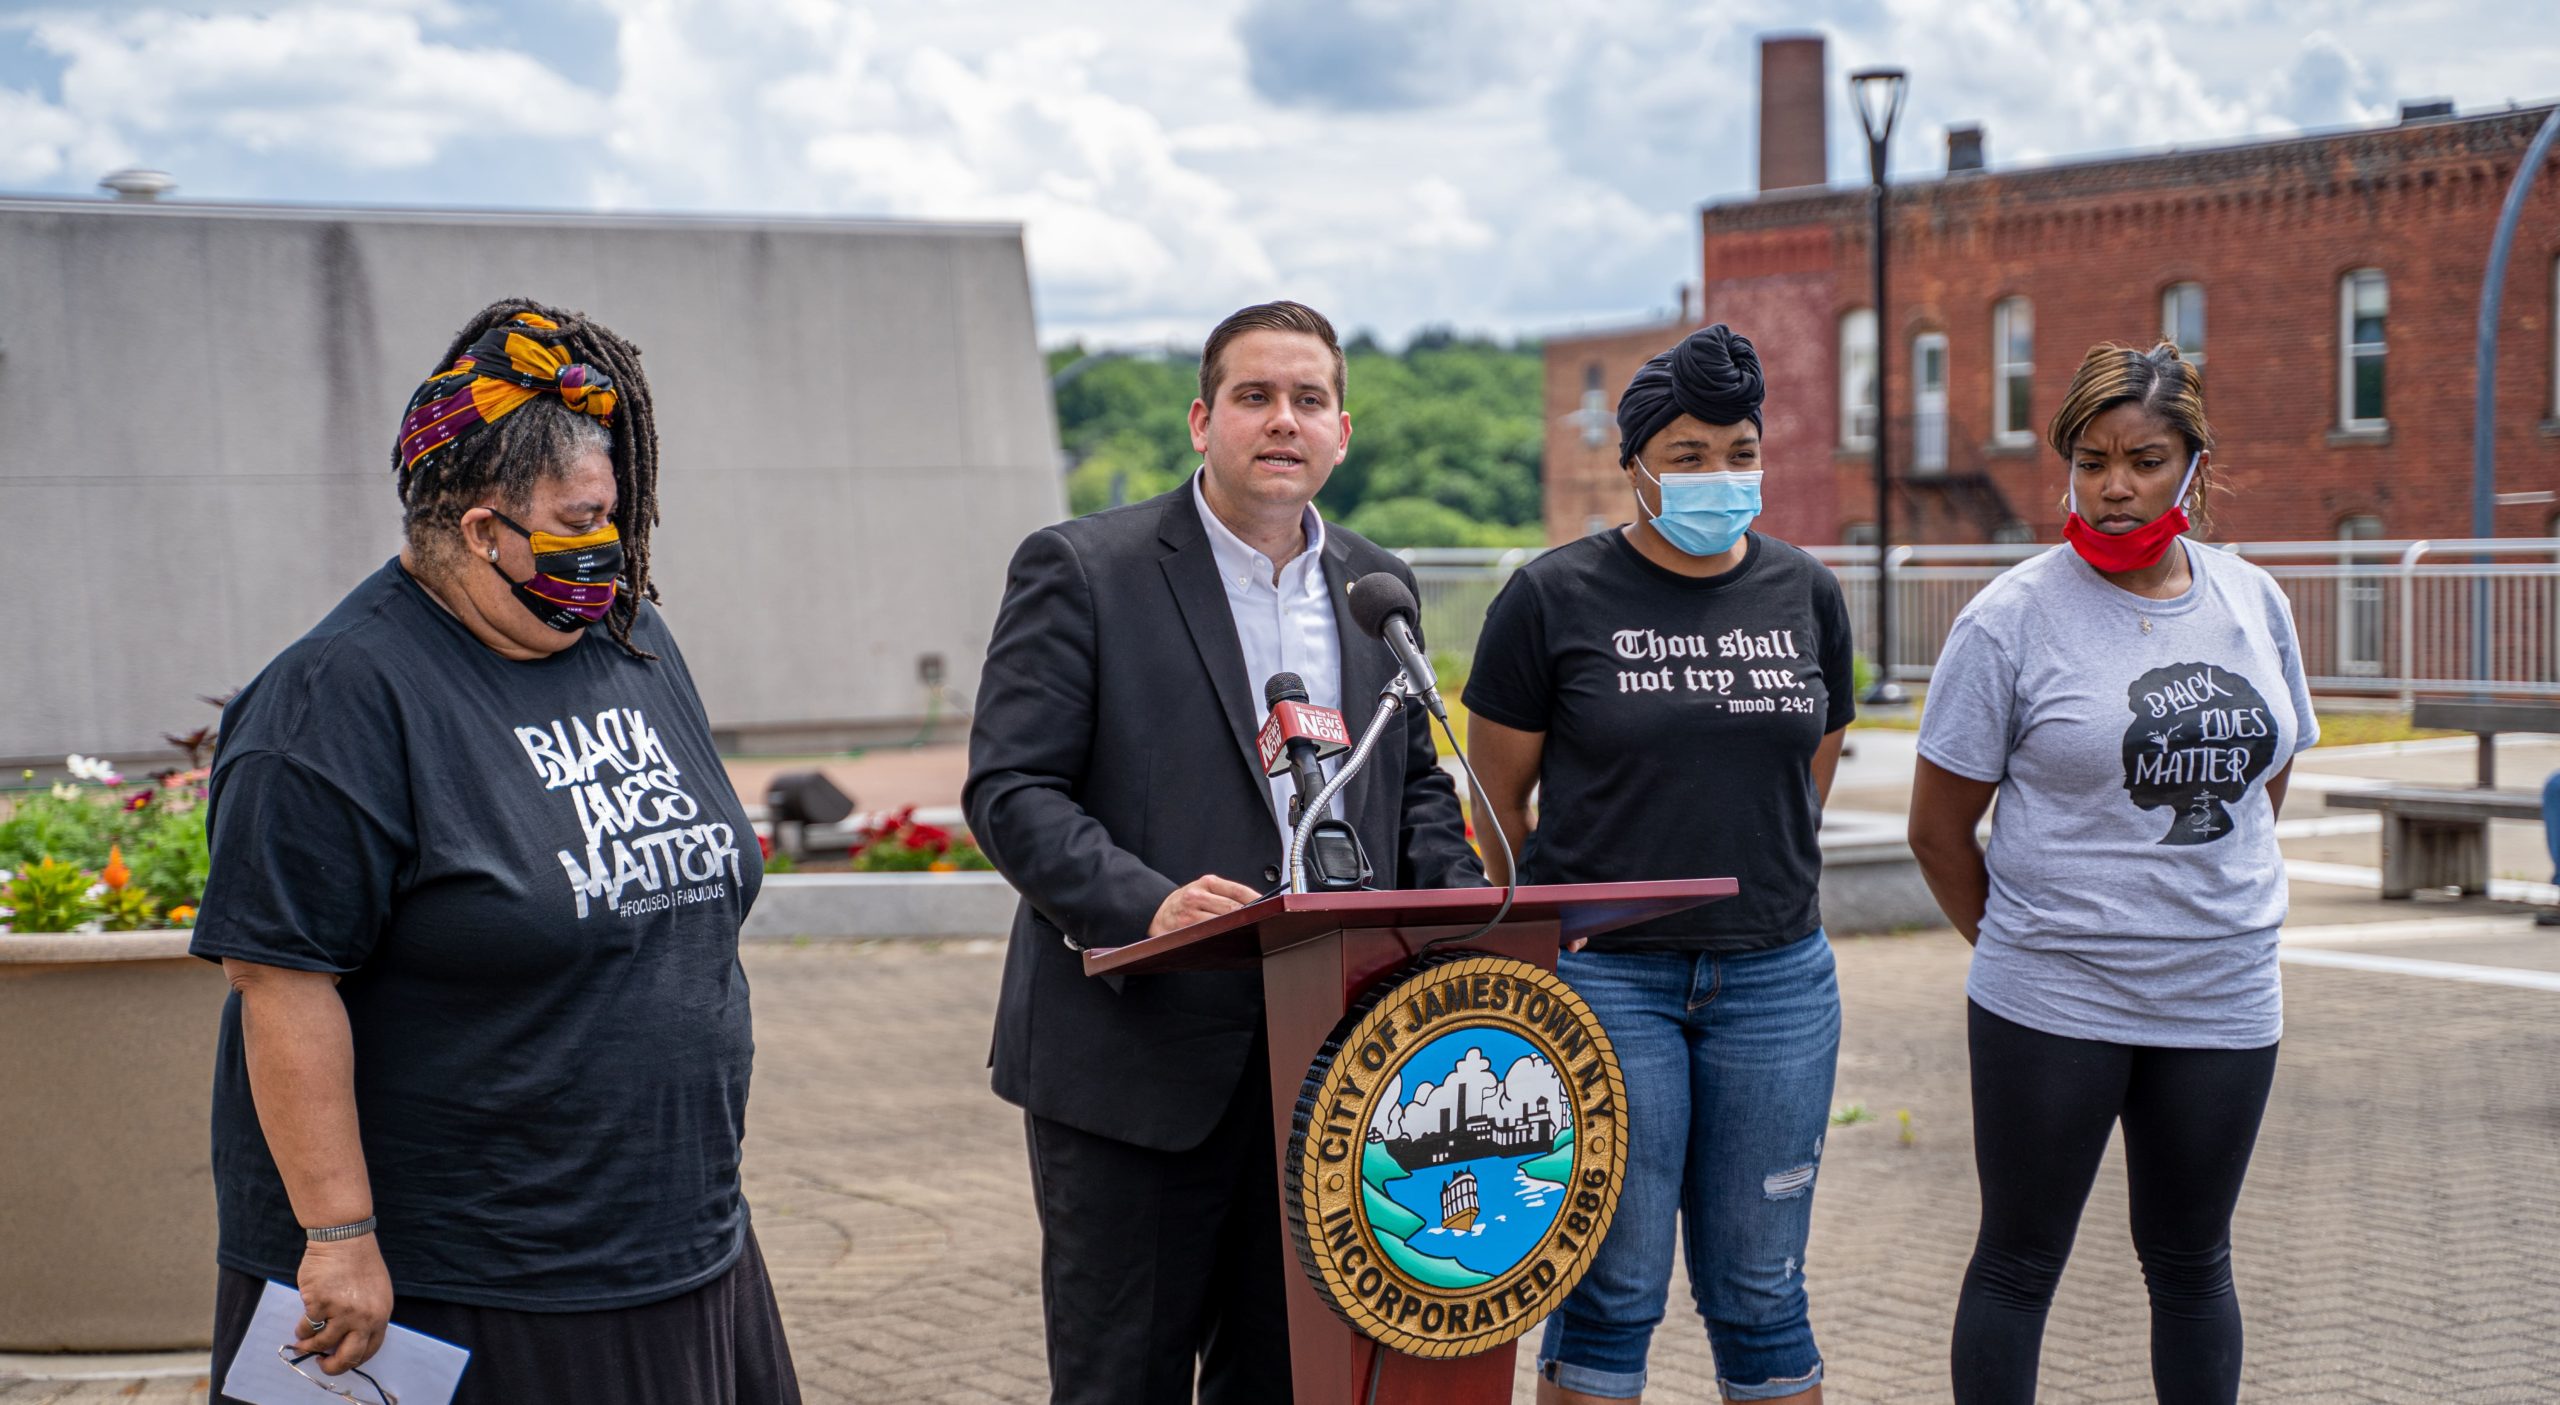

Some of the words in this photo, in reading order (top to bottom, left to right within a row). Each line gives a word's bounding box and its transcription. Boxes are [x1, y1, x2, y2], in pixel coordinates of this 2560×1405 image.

[1612, 629, 1709, 662] Thou
[1717, 629, 1800, 661] shall
[1617, 665, 1675, 693] not
[1683, 665, 1735, 695] try
[1748, 668, 1806, 690] me.
[2144, 667, 2233, 718] BLACK
[1728, 696, 1775, 713] mood
[1780, 696, 1814, 713] 24:7
[2199, 707, 2268, 742] LIVES
[514, 708, 680, 790] BLACK
[2134, 746, 2251, 785] MATTER
[571, 769, 698, 848] LIVES
[558, 823, 743, 919] MATTER
[620, 893, 669, 918] #FOCUSED
[677, 883, 725, 906] FABULOUS
[1321, 1074, 1366, 1163] CITY
[1361, 1022, 1400, 1071] OF
[1407, 978, 1589, 1061] JAMESTOWN
[1324, 1206, 1557, 1334] INCORPORATED
[1558, 1168, 1607, 1253] 1886
